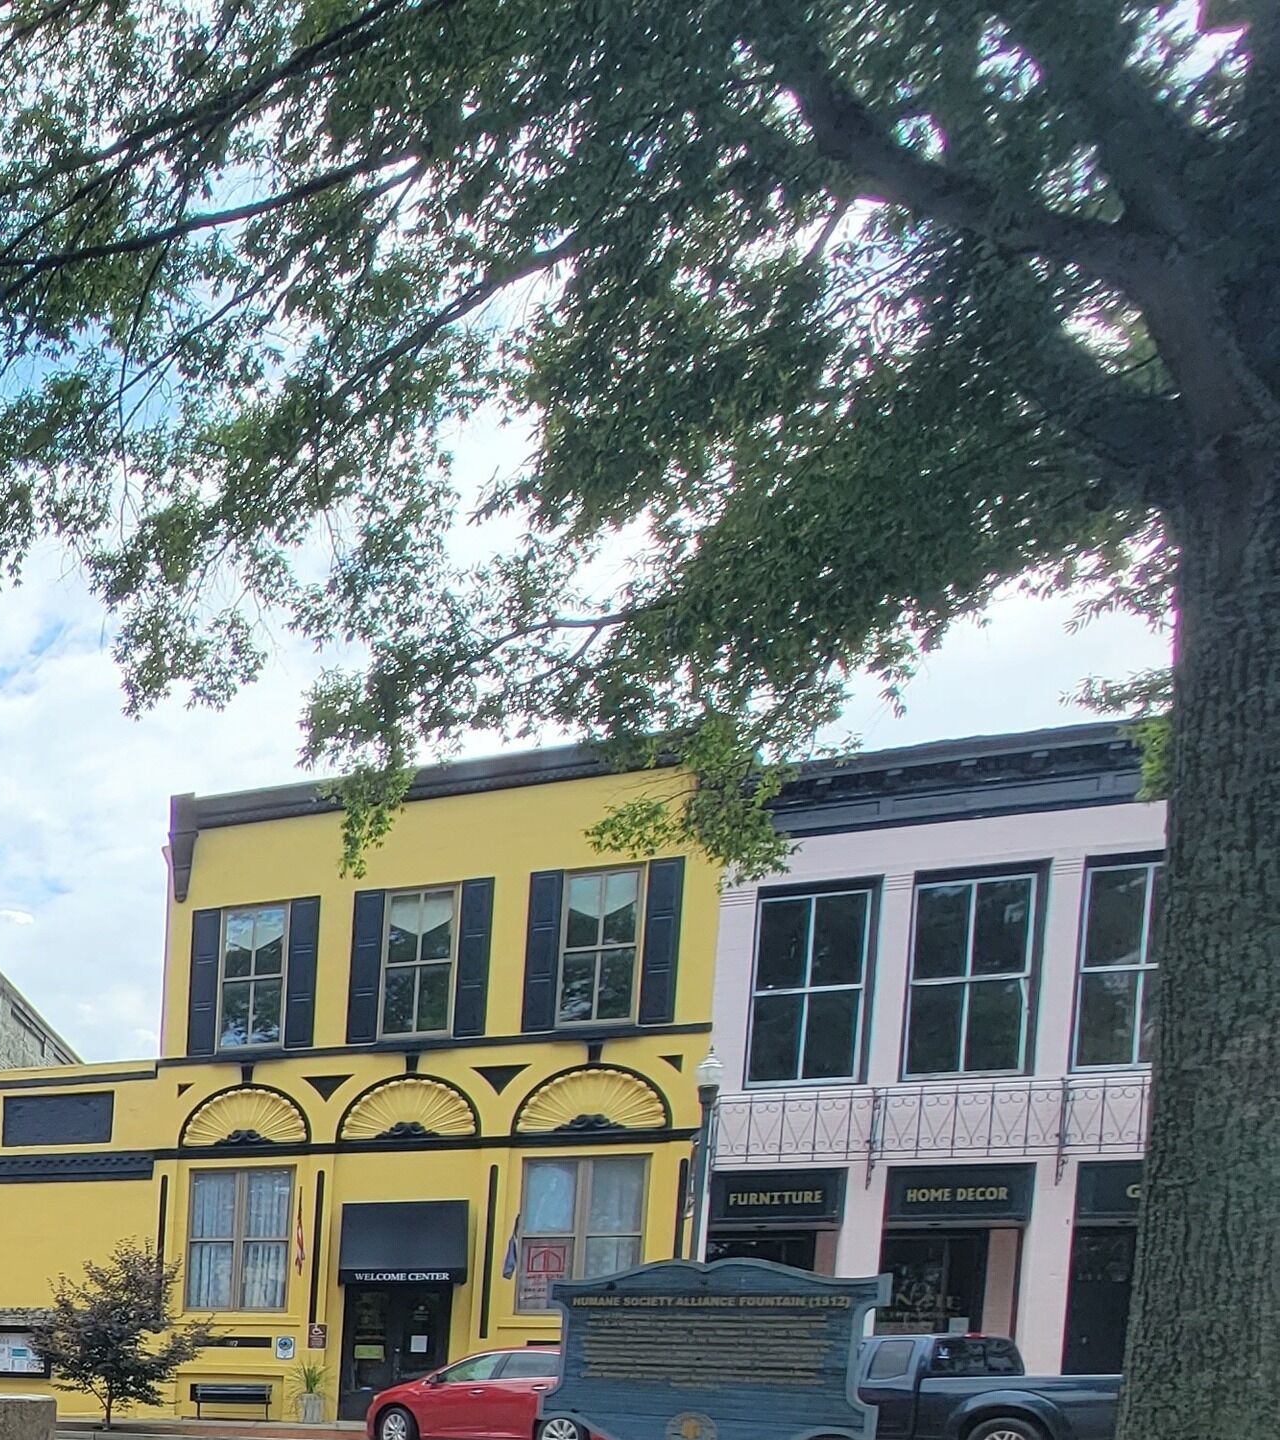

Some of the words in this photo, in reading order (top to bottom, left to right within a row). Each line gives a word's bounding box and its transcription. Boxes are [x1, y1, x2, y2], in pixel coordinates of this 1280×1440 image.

[728, 1190, 824, 1206] FURNITURE
[906, 1187, 952, 1203] HOME
[956, 1186, 1009, 1202] DECOR
[354, 1272, 407, 1281] WELCOME
[407, 1272, 451, 1281] CENTER
[572, 1296, 621, 1307] HUMANE
[622, 1296, 673, 1307] SOCIETY
[675, 1296, 737, 1307] ALLIANCE
[739, 1296, 806, 1307] FOUNTAIN
[808, 1296, 850, 1309] (1912)
